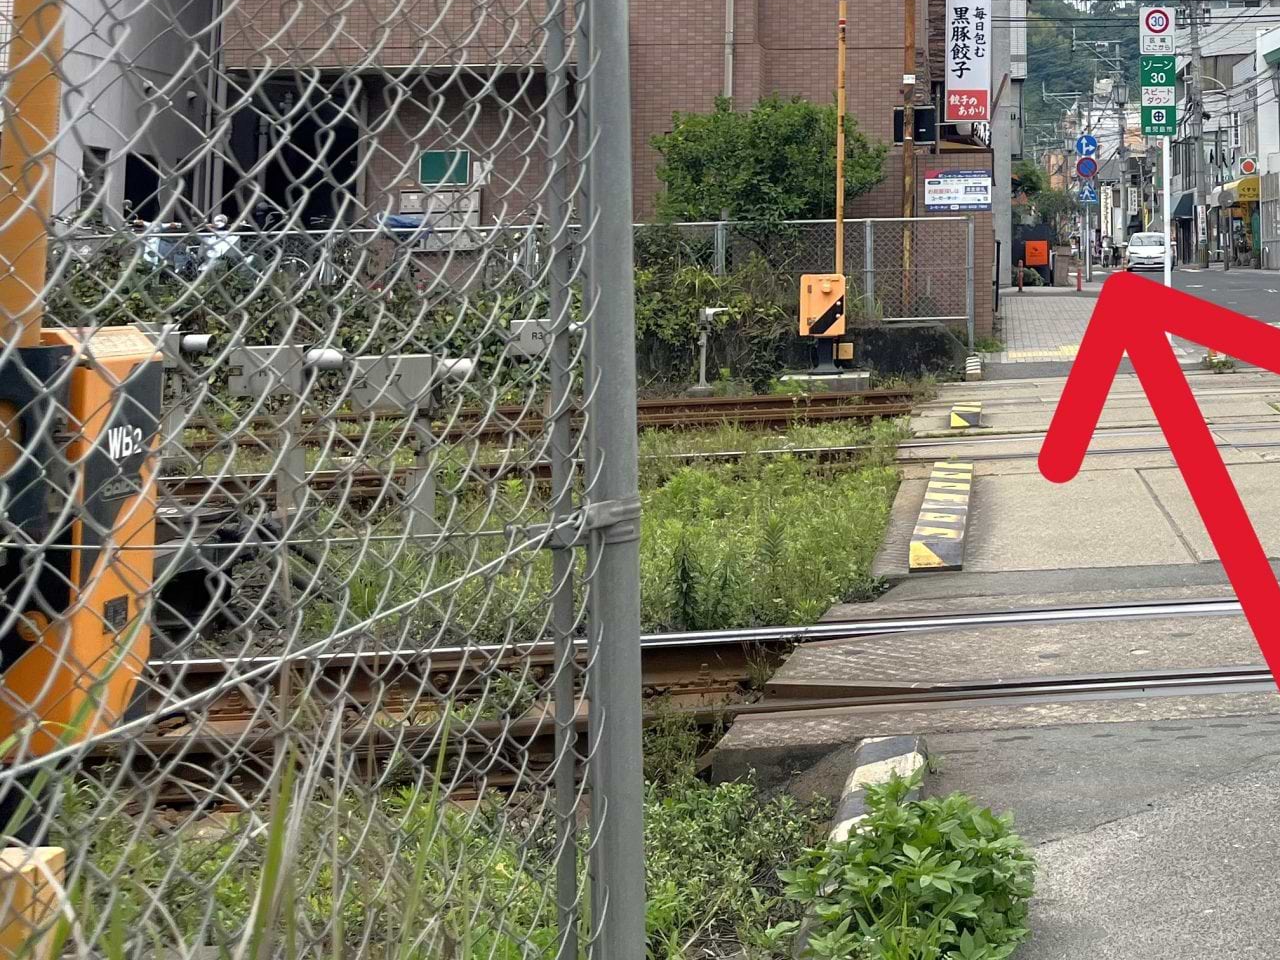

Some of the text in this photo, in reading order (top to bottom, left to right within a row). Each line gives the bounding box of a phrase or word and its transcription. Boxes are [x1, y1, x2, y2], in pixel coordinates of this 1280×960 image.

[1150, 16, 1165, 27] 30
[973, 6, 987, 58] 毎日包む
[950, 6, 972, 79] 黒豚餃子
[1142, 60, 1173, 71] ゾーン
[1150, 72, 1166, 83] 30
[1143, 87, 1174, 96] スピード
[949, 94, 977, 105] 餃子の
[1147, 96, 1171, 105] ダウン
[958, 105, 985, 116] あかり
[531, 331, 544, 340] R3
[108, 424, 142, 460] WB2
